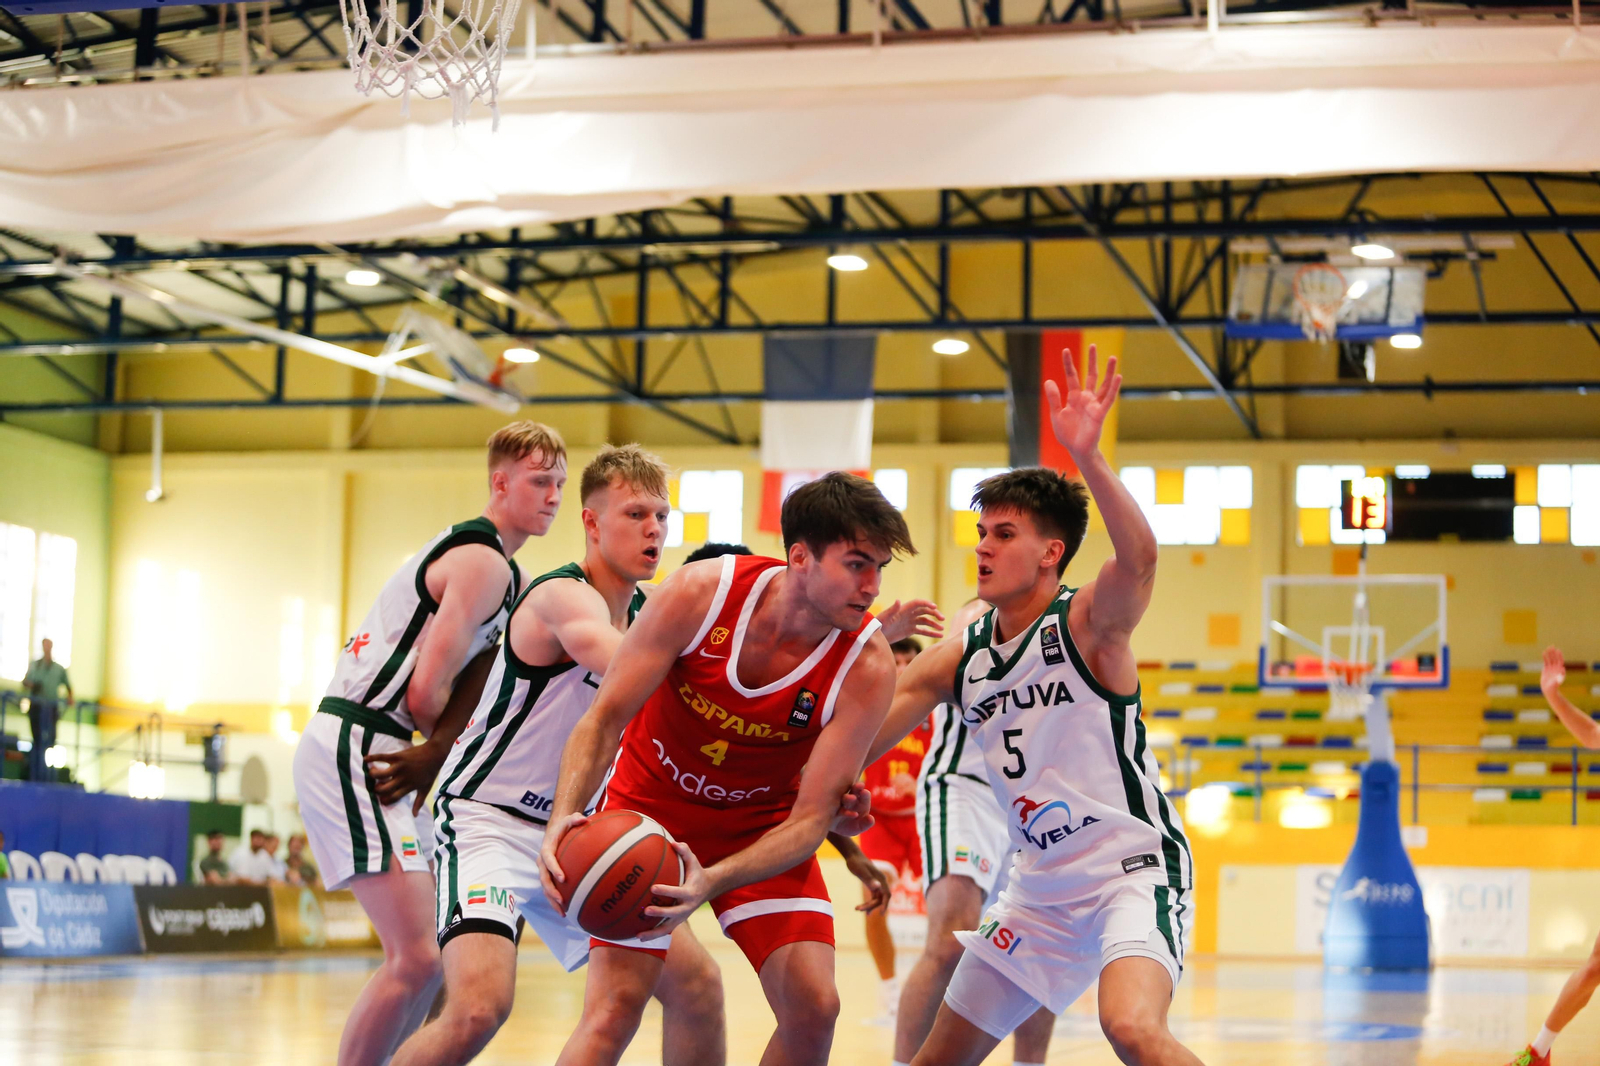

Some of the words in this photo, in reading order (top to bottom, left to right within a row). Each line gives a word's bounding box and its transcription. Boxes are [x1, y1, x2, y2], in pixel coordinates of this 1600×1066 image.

[1044, 648, 1060, 657] FIBA
[678, 682, 790, 742] ESPAÑA
[792, 710, 809, 721] FIBA
[962, 681, 1076, 724] LIETUVA
[699, 739, 730, 766] 4
[1002, 728, 1027, 779] 5
[601, 864, 645, 913] molten
[979, 920, 1023, 956] MSI
